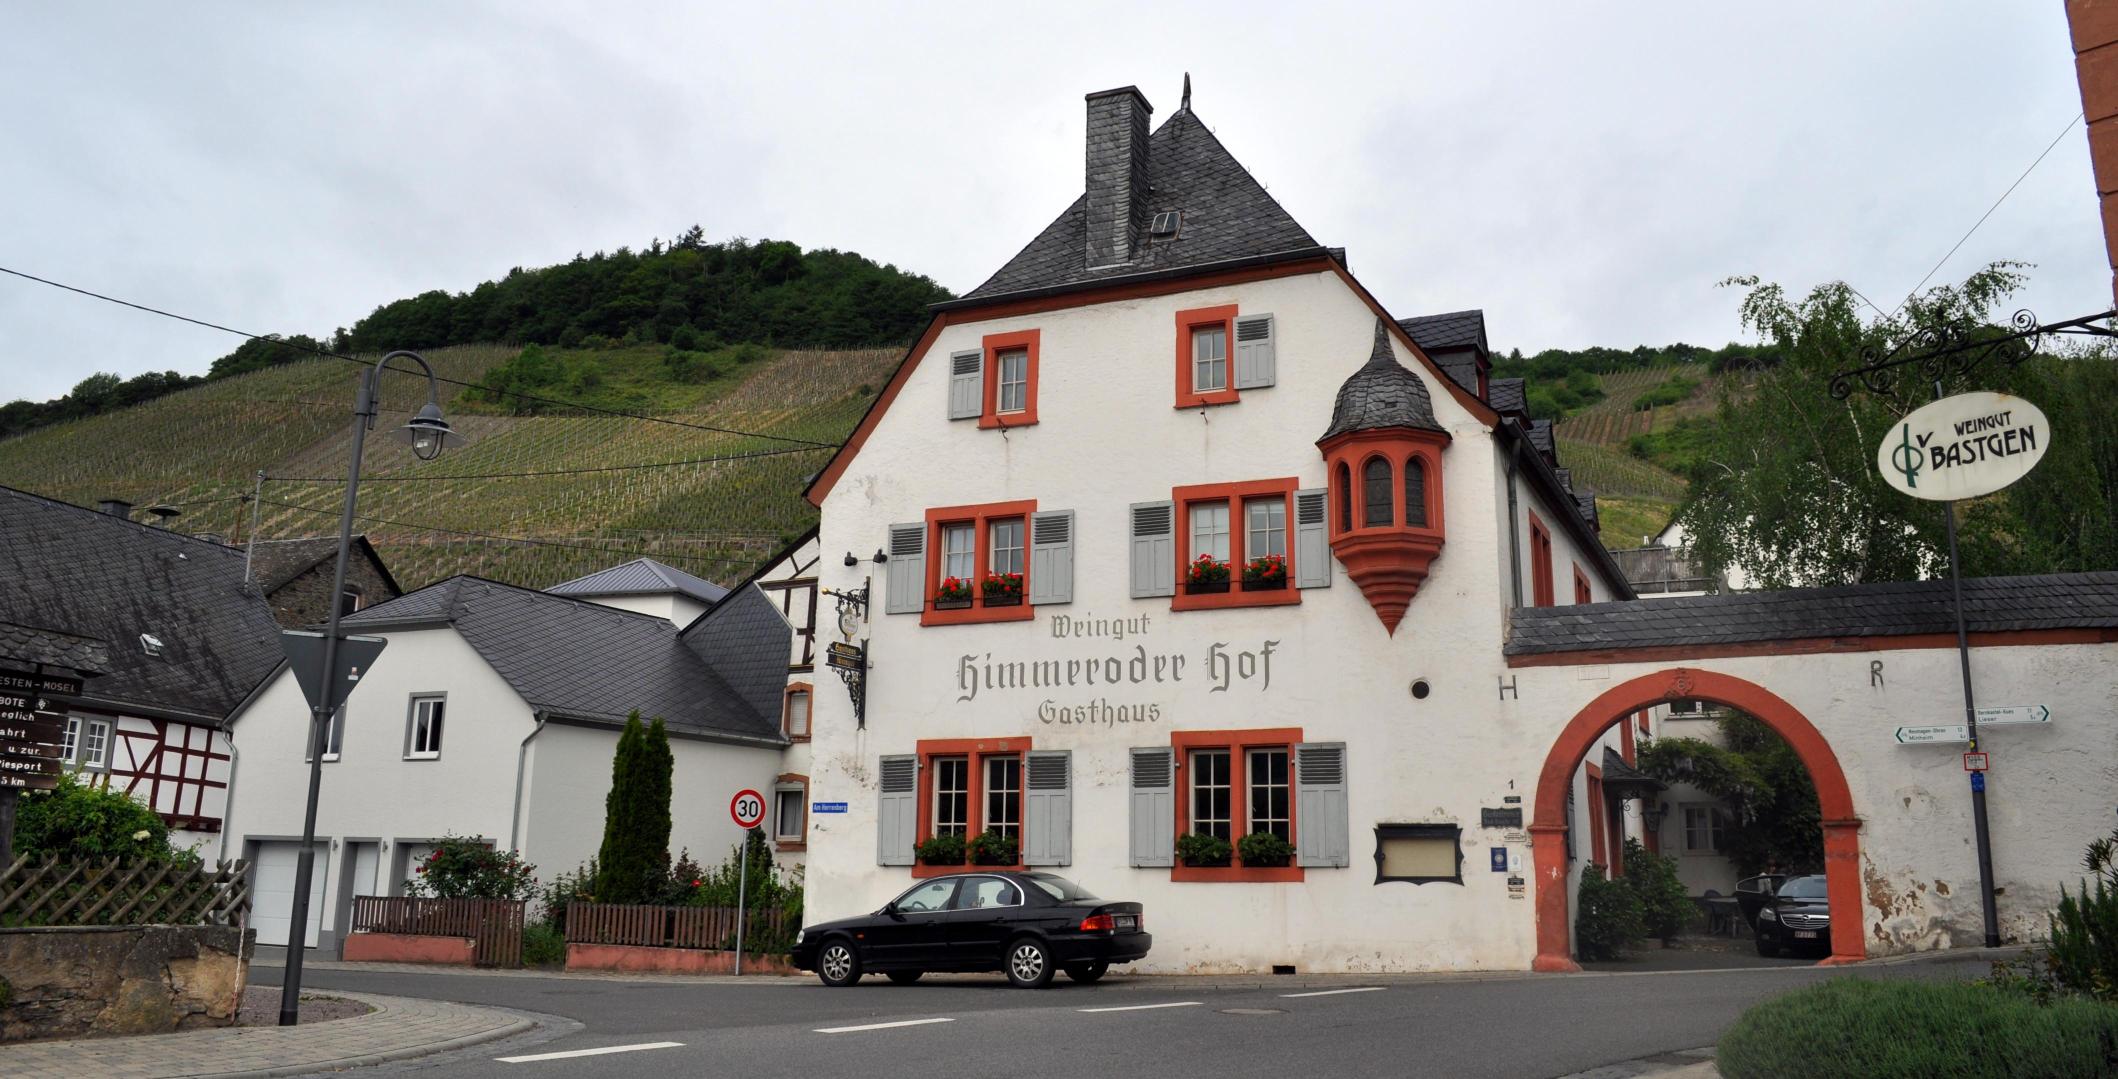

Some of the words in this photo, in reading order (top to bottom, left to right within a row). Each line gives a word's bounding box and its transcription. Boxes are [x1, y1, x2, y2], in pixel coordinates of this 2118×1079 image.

[1954, 411, 2012, 437] WEINGUT
[1930, 425, 2037, 471] BASTGEN
[1050, 612, 1151, 641] Weingut
[956, 644, 1187, 703] Himmeroder
[1204, 639, 1281, 694] Hof
[1038, 698, 1161, 729] Gasthaus
[11, 776, 26, 787] km
[1507, 778, 1514, 790] 1
[738, 799, 759, 818] 30
